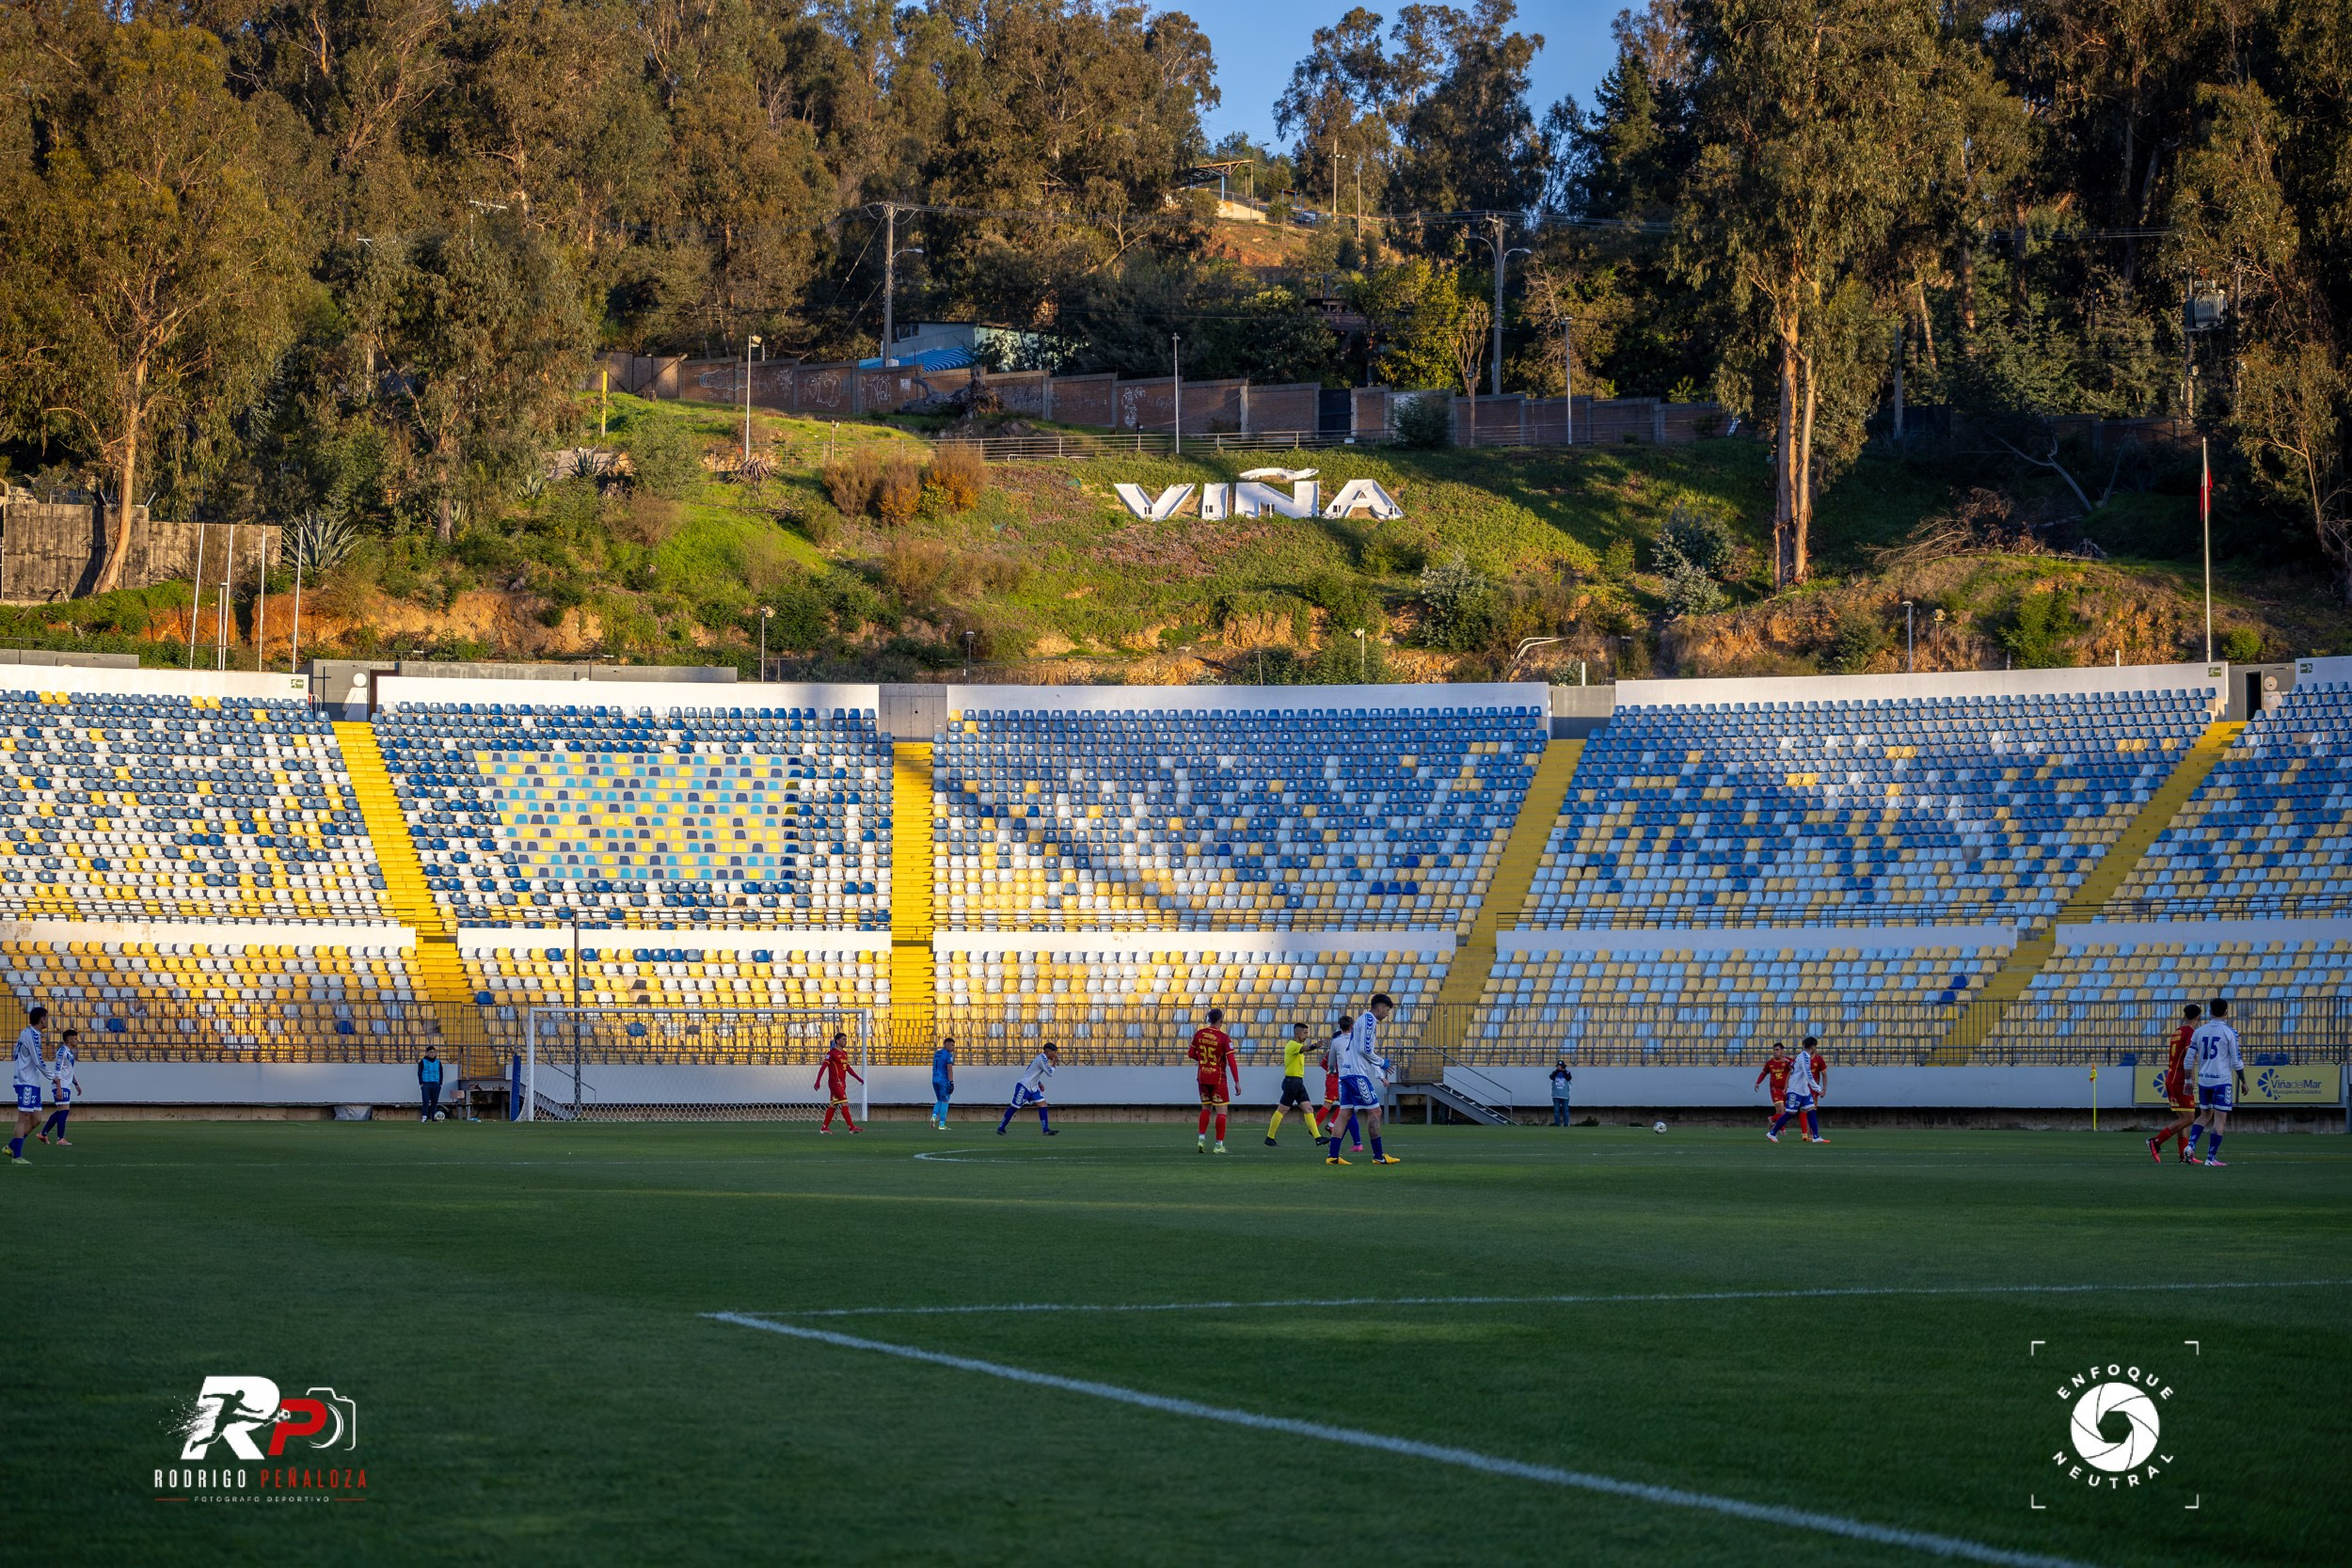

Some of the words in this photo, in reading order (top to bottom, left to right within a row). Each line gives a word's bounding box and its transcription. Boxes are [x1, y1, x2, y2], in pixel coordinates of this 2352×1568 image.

[1114, 467, 1404, 520] VIÑA
[1199, 1045, 1217, 1066] 35
[2201, 1037, 2220, 1060] 15
